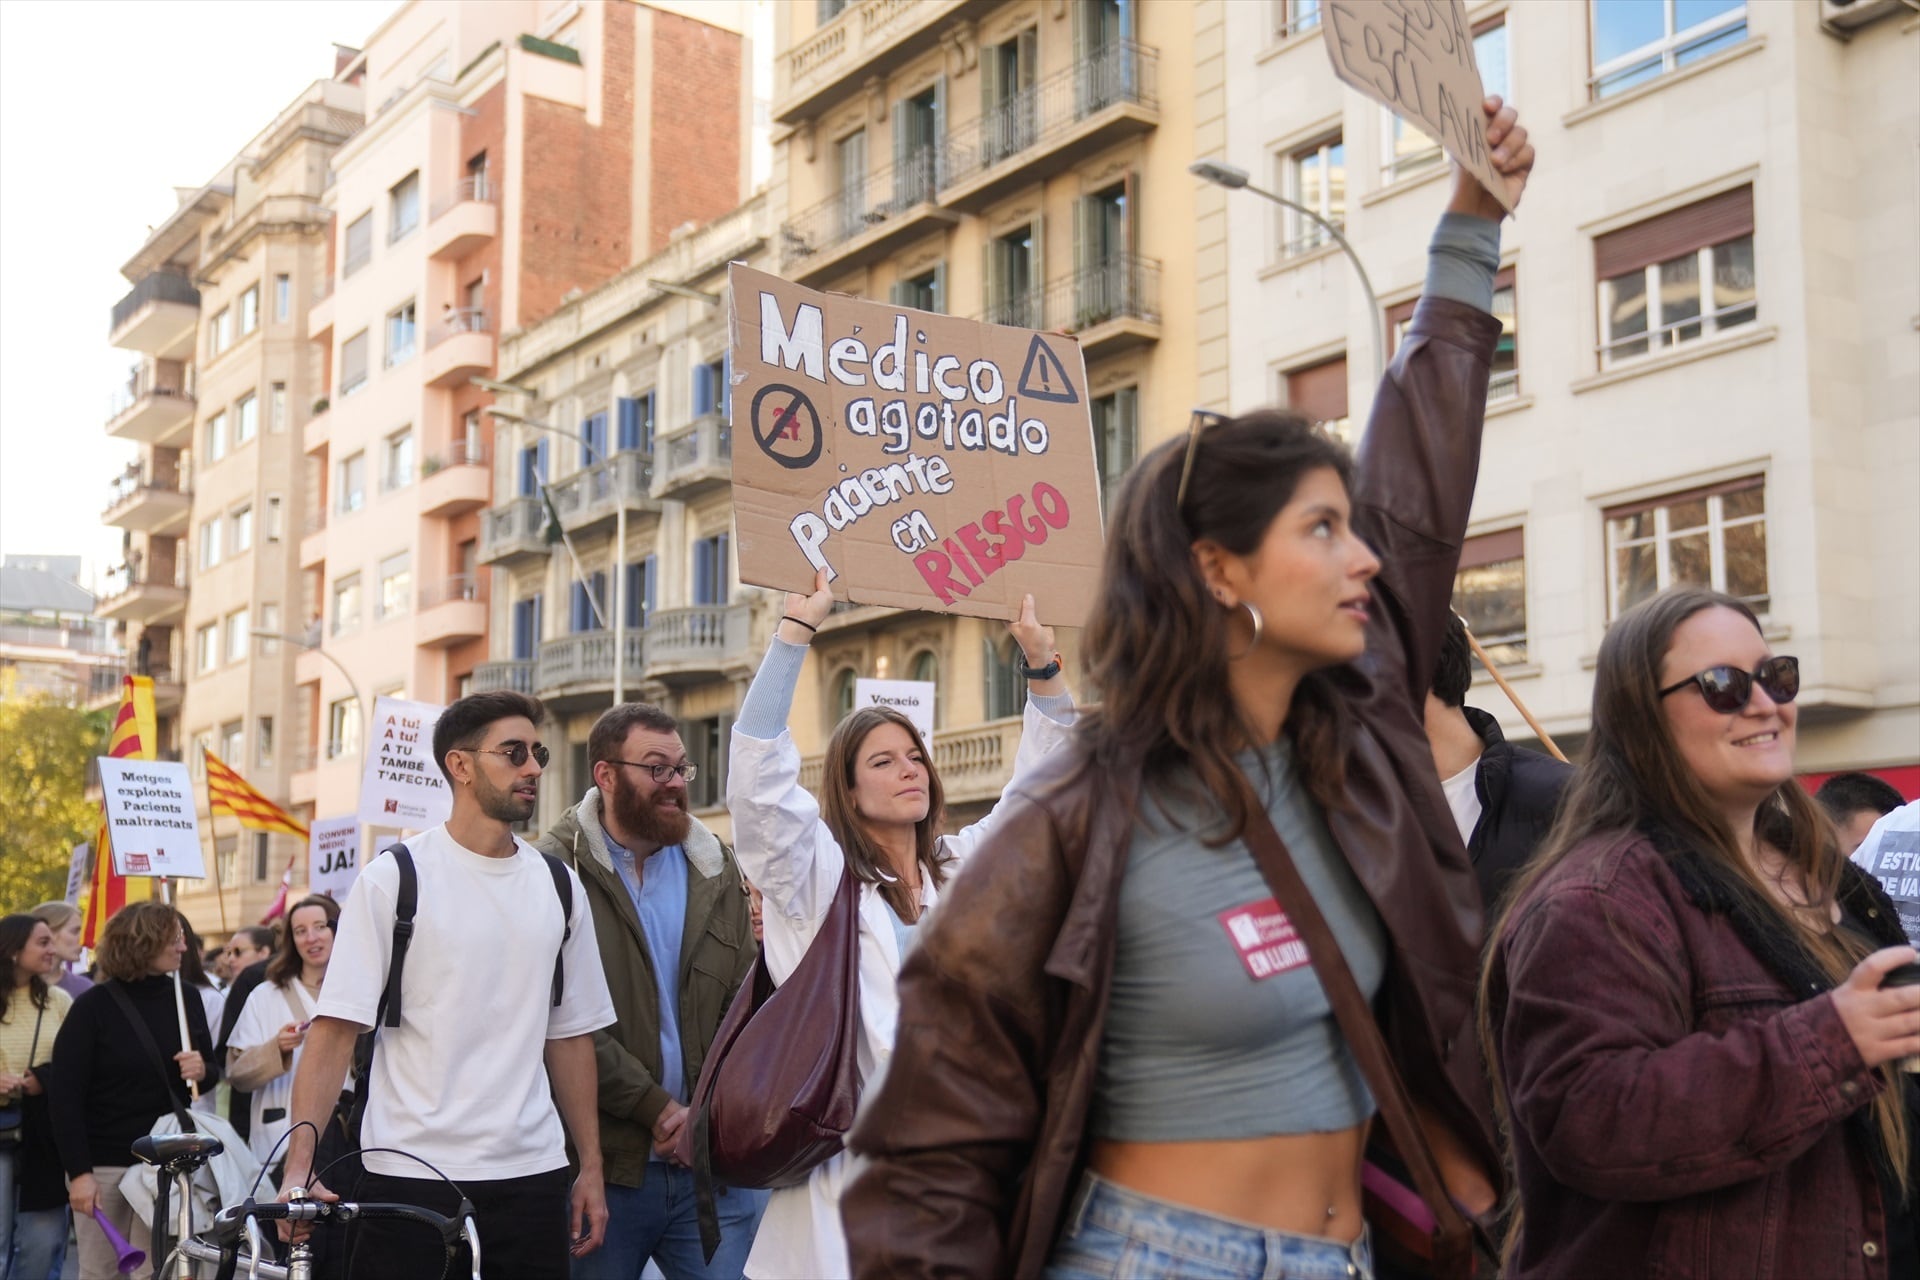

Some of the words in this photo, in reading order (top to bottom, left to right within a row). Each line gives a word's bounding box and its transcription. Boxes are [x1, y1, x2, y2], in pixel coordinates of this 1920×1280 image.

[759, 291, 1005, 404] Médico
[846, 397, 1049, 456] agotado
[891, 509, 937, 554] en
[912, 481, 1069, 606] RIESGO
[871, 694, 919, 705] Vocació
[386, 715, 396, 726] A
[401, 717, 420, 729] tu!
[384, 728, 393, 740] A
[399, 731, 418, 743] tu!
[381, 743, 390, 752] A
[395, 744, 412, 756] TU
[380, 756, 425, 772] TAMBÉ
[121, 771, 171, 785] Metges
[378, 770, 443, 788] T'AFECTA!
[117, 786, 181, 799] explotats
[122, 800, 181, 814] Pacients
[115, 815, 193, 830] maltractats
[319, 847, 355, 874] JA!
